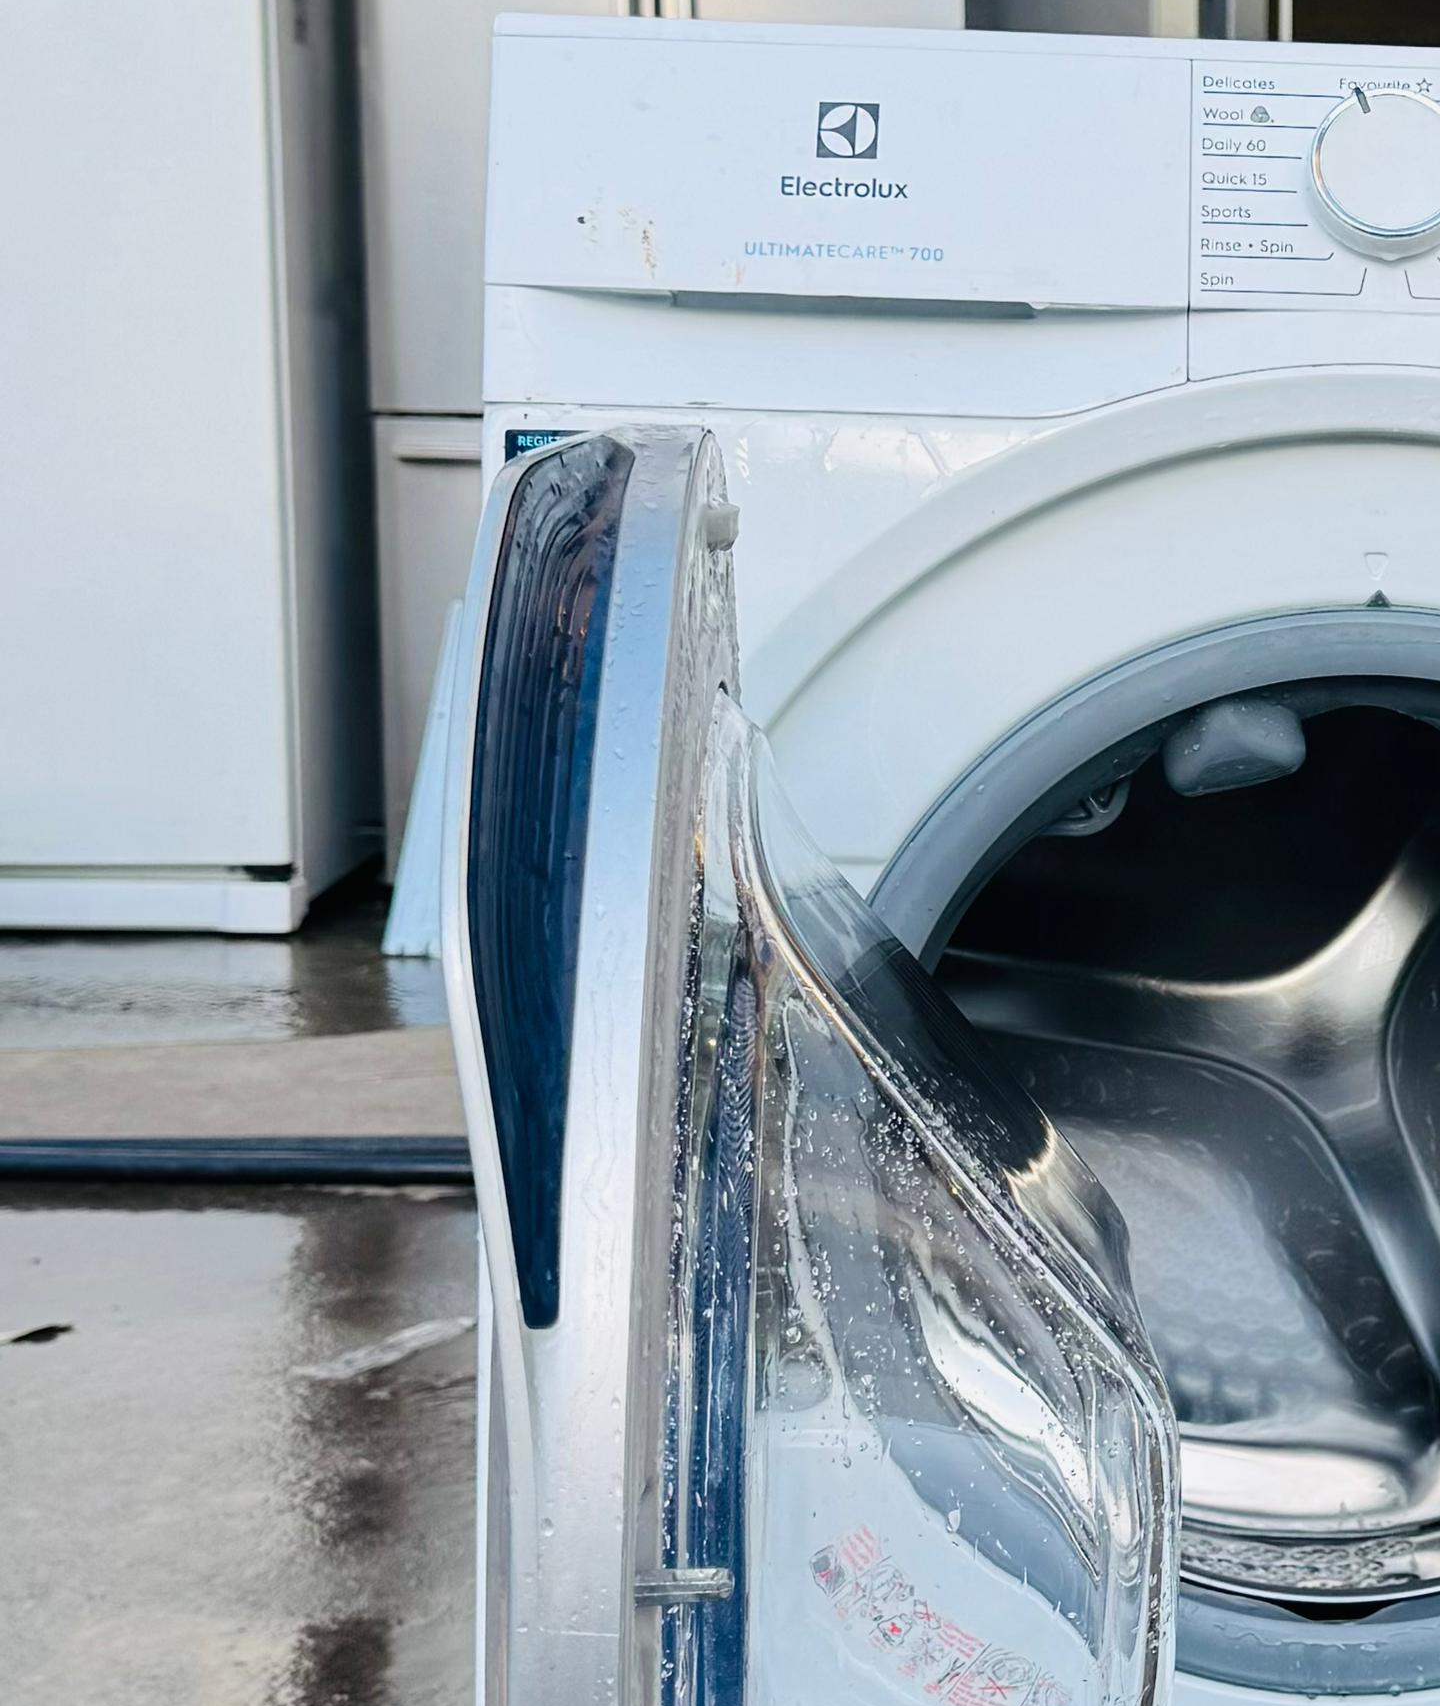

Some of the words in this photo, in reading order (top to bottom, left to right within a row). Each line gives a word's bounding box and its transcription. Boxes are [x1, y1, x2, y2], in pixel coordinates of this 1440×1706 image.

[1203, 76, 1275, 90] Delicates
[1203, 107, 1243, 120] Wool
[1202, 138, 1241, 152] Daily
[1246, 139, 1266, 151] 60
[1202, 171, 1247, 186] Quick
[1251, 172, 1267, 186] 15
[780, 175, 908, 199] Electrolux
[1201, 205, 1251, 221] Sports
[910, 246, 944, 262] 700
[1201, 238, 1240, 253] Rinse
[1260, 239, 1294, 256] Spin
[1201, 272, 1234, 288] Spin
